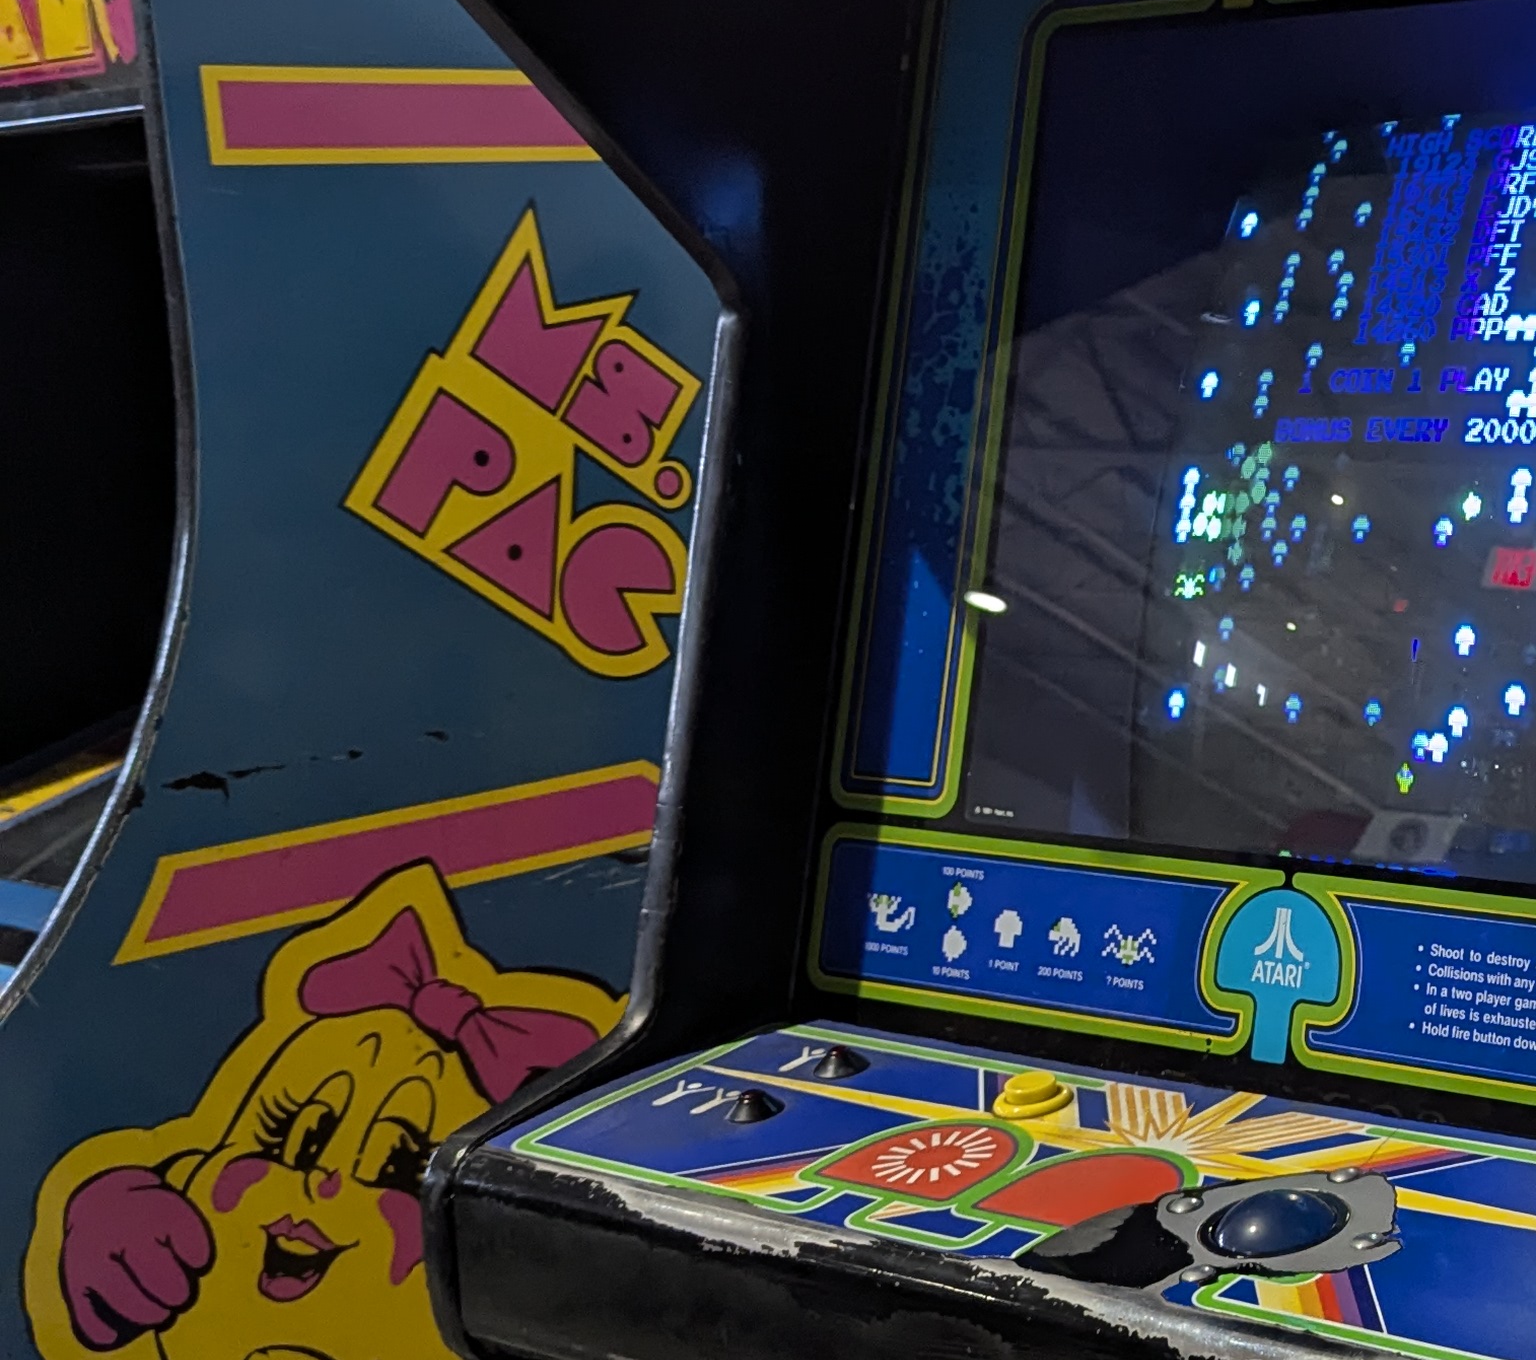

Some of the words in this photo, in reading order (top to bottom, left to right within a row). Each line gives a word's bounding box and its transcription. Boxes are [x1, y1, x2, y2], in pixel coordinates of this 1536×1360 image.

[1386, 131, 1454, 157] HIGH
[1494, 267, 1516, 291] Z
[1455, 292, 1509, 317] CAD
[1329, 367, 1396, 394] COIN
[1406, 368, 1422, 392] 1
[1439, 366, 1511, 393] PLAY
[1274, 417, 1352, 443] BONUS
[1365, 417, 1450, 443] EVERY
[955, 868, 985, 880] POINTS
[881, 943, 909, 956] POINTS
[1430, 943, 1465, 961] Shoot
[1469, 949, 1482, 962] to
[1486, 951, 1531, 972] destroy
[941, 967, 970, 980] POINTS
[994, 960, 1020, 971] POINT
[1037, 966, 1051, 977] 200
[1052, 967, 1084, 981] POINTS
[1251, 959, 1303, 988] ATARI
[1428, 963, 1485, 983] Collisions
[1486, 972, 1512, 986] with
[1513, 978, 1536, 993] any
[1113, 976, 1145, 990] POINTS
[1426, 982, 1438, 995] In
[1440, 987, 1448, 998] a
[1451, 987, 1473, 1001] two
[1475, 990, 1512, 1008] player
[1424, 1003, 1437, 1016] of
[1439, 1004, 1466, 1020] lives
[1469, 1007, 1480, 1022] is
[1421, 1021, 1449, 1038] Hold
[1451, 1025, 1471, 1040] fire
[1473, 1029, 1511, 1047] button
